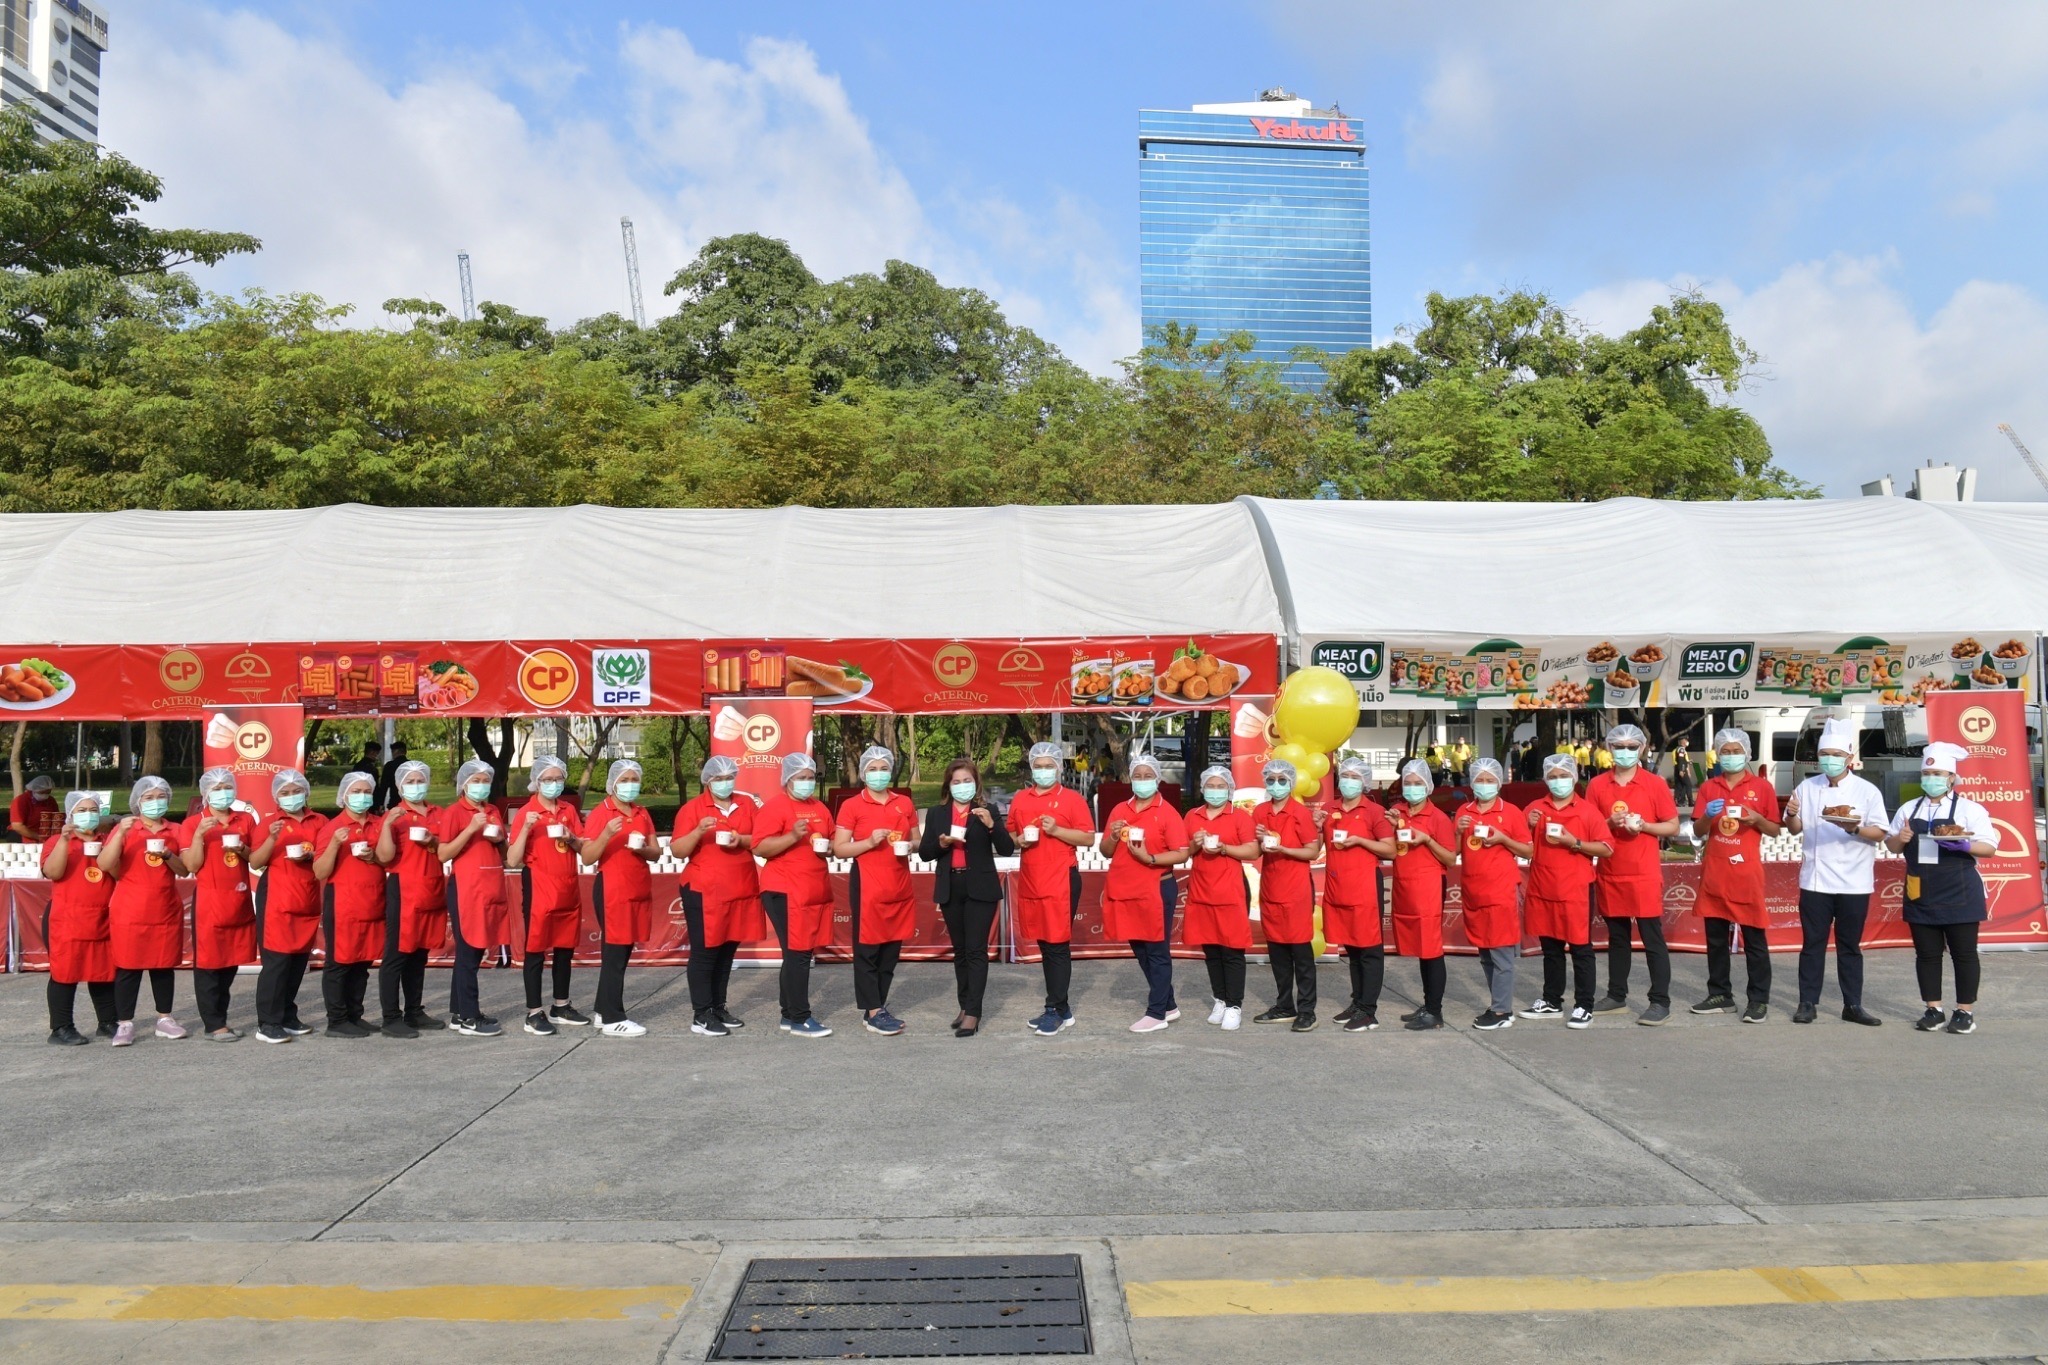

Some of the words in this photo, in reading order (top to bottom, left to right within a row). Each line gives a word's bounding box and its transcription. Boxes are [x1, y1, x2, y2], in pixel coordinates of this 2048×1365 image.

[1250, 117, 1356, 142] Yakult
[1319, 649, 1357, 660] MEAT
[1688, 650, 1727, 661] MEAT
[165, 662, 197, 681] CP
[938, 656, 972, 675] CP
[1686, 662, 1726, 673] ZERO
[527, 667, 569, 691] CP
[603, 692, 641, 703] CPF
[923, 690, 989, 703] CATERING
[1362, 685, 1384, 703] เนื้อ
[1678, 684, 1702, 701] พืช
[1727, 682, 1749, 700] เนื้อ
[1963, 717, 1990, 733] CP
[239, 732, 267, 749] CP
[747, 725, 775, 742] CP
[1966, 745, 2007, 756] TERING
[734, 754, 784, 766] CATERIN
[226, 762, 280, 774] CATERING
[1721, 820, 1735, 830] CP
